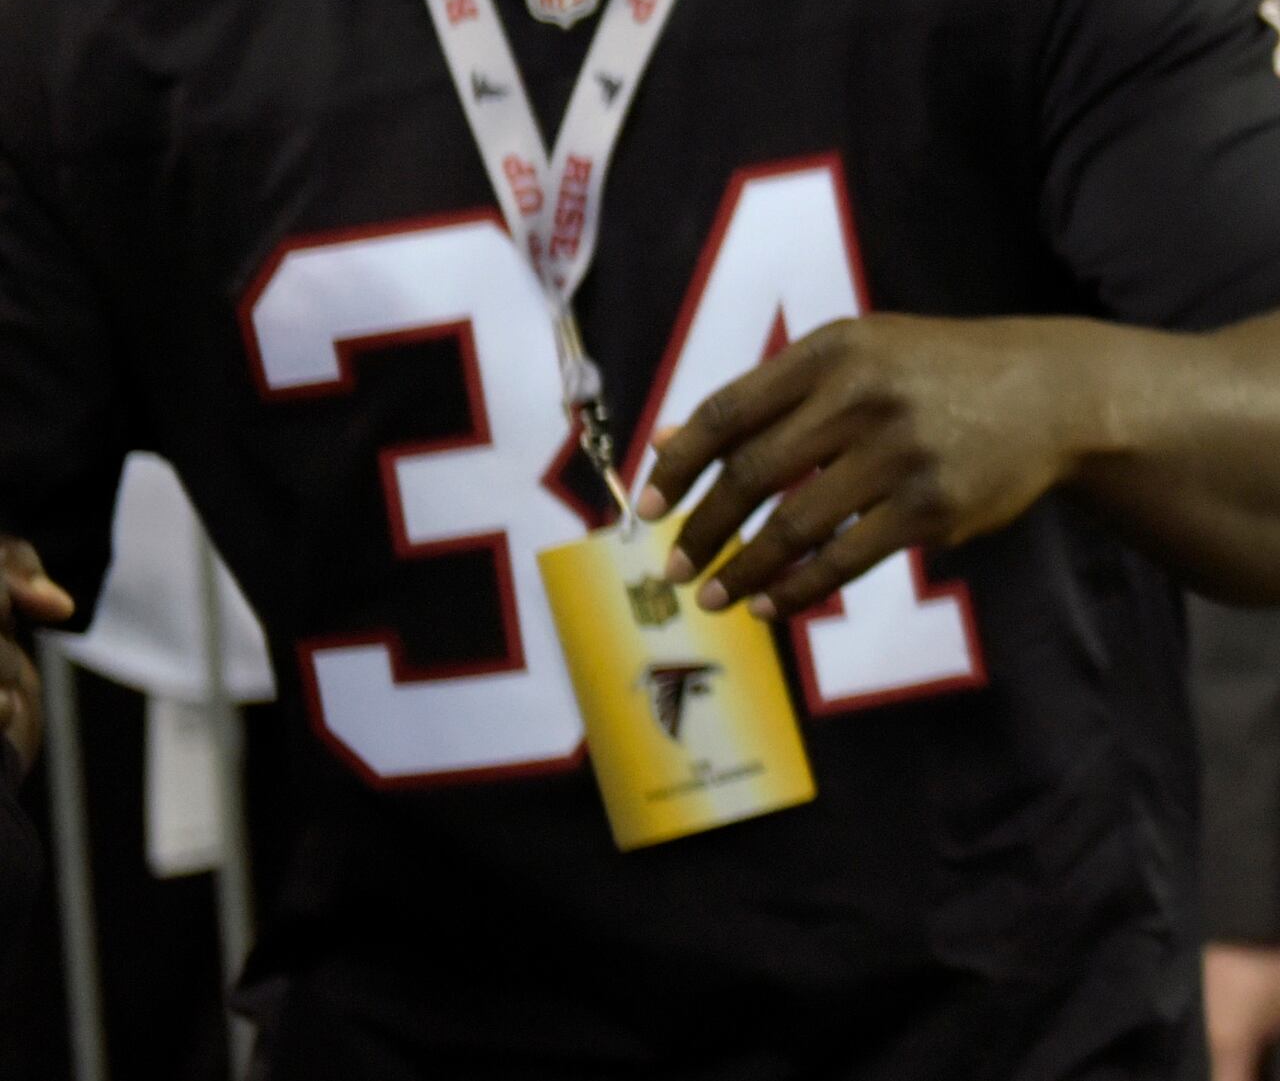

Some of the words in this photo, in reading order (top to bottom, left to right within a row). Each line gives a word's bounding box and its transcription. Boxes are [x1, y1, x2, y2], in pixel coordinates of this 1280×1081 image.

[502, 151, 545, 218] UP
[548, 153, 593, 262] RISE
[239, 151, 988, 790] 34
